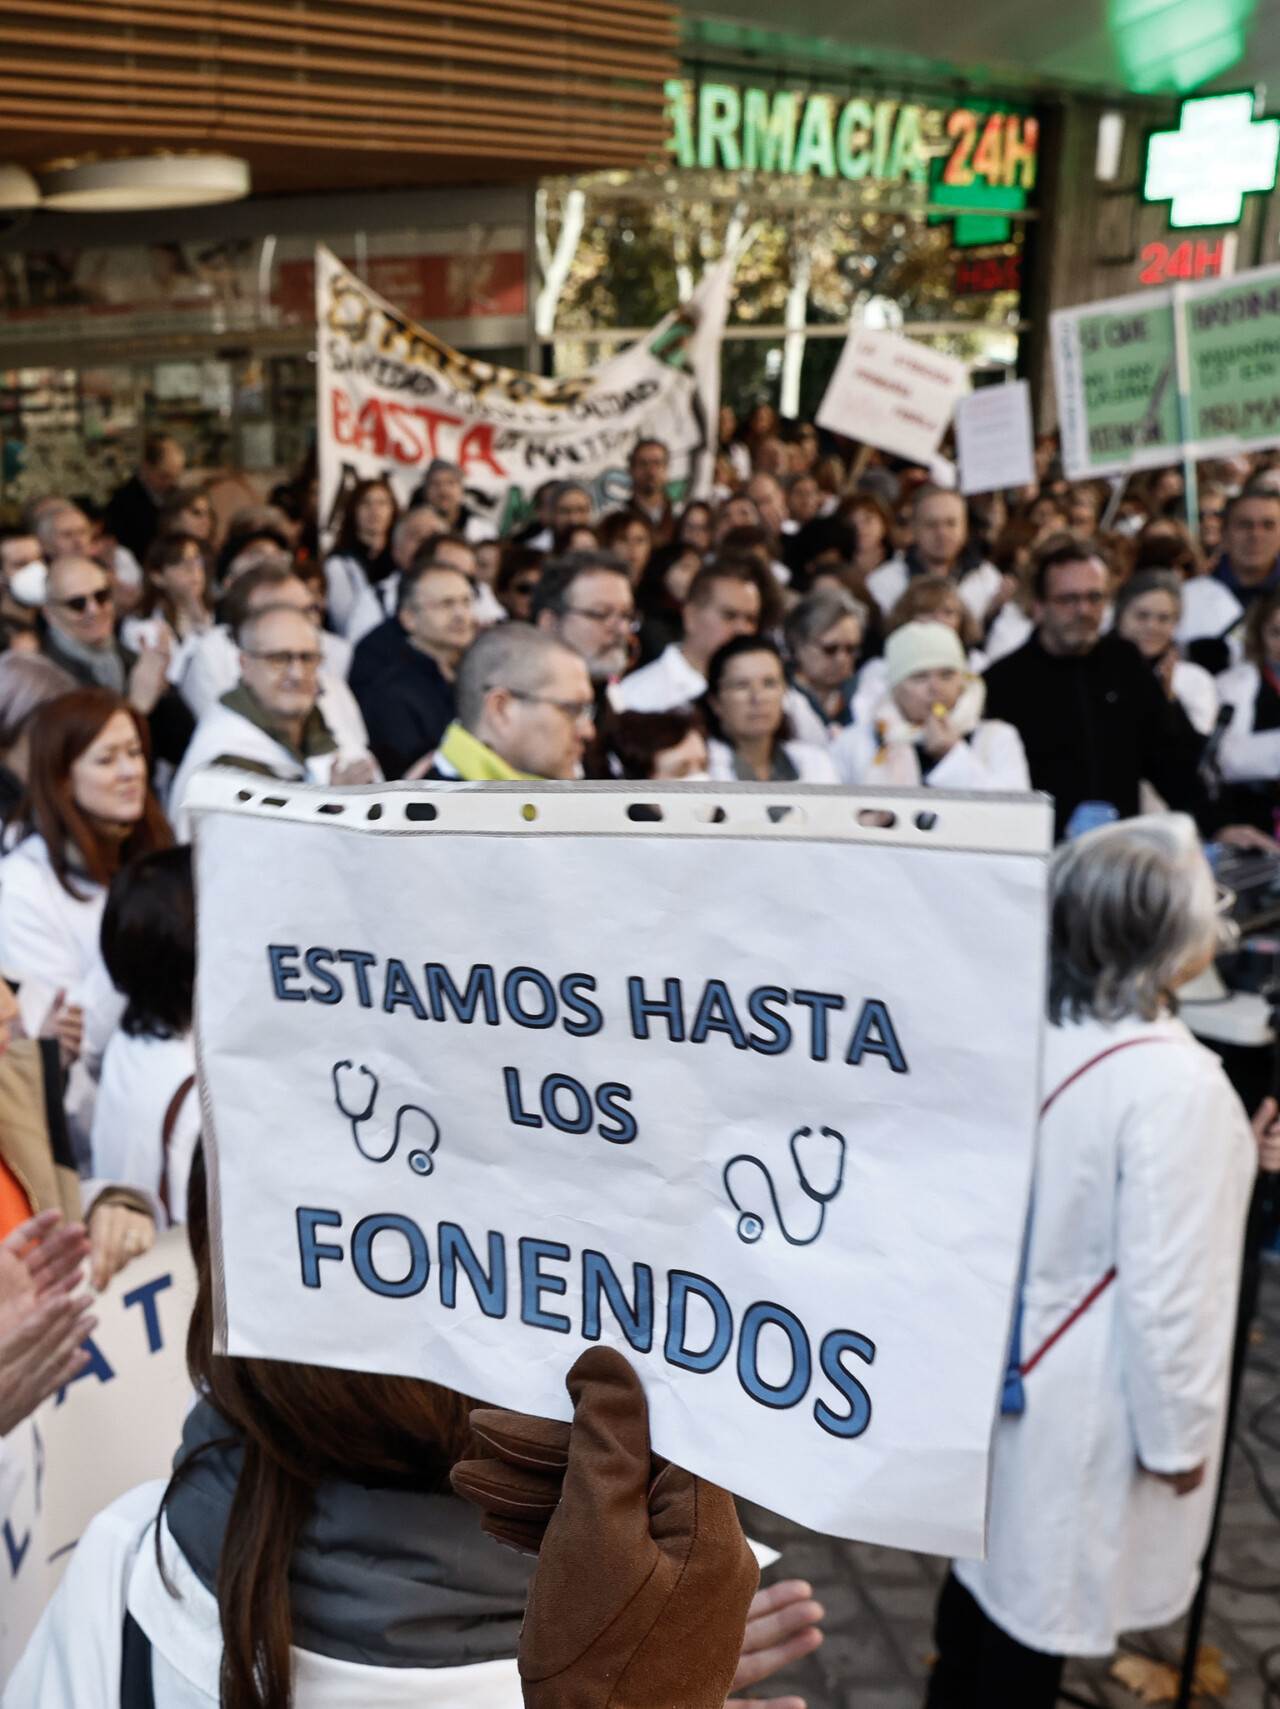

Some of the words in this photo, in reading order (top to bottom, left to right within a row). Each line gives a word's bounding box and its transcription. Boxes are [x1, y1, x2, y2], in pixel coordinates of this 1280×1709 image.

[942, 109, 1040, 189] 24H
[1139, 241, 1224, 285] 24H
[267, 943, 603, 1036] ESTAMOS
[628, 975, 910, 1074] HASTA
[502, 1066, 638, 1145] LOS
[295, 1206, 877, 1440] FONENDOS
